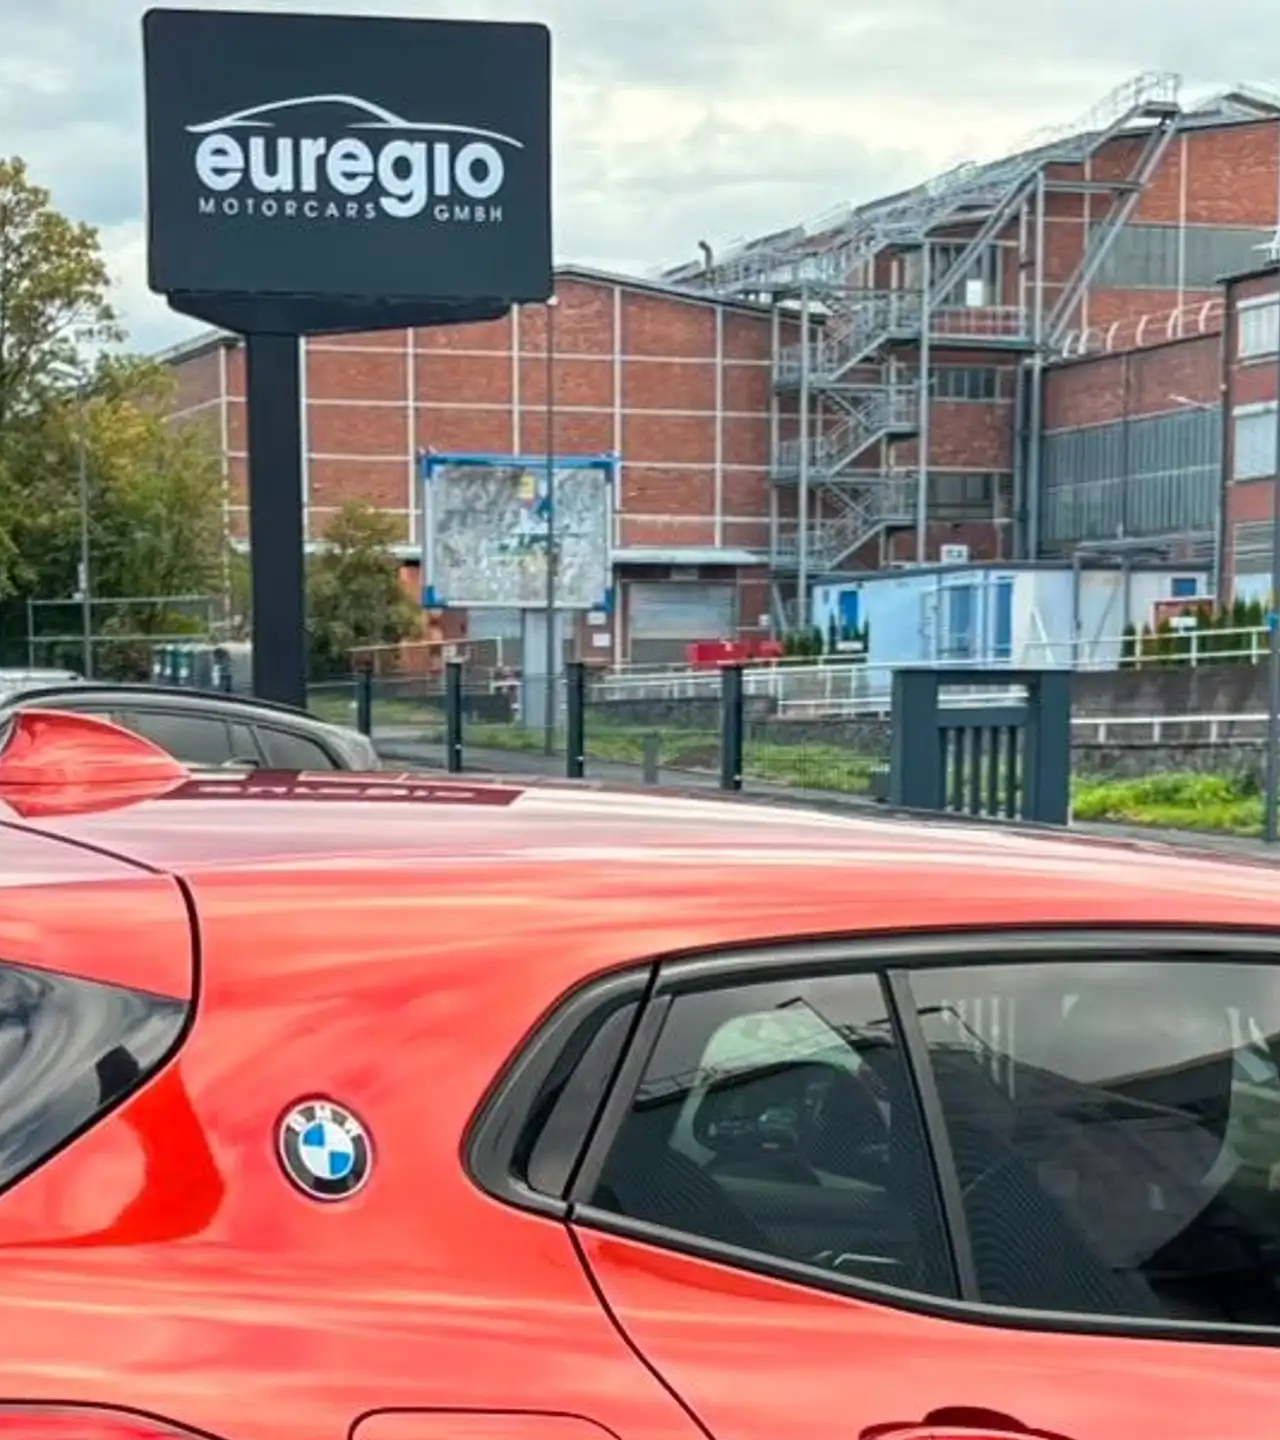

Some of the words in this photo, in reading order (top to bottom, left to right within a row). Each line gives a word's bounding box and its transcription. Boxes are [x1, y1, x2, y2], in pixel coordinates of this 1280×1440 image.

[195, 134, 505, 218] euregio
[198, 198, 377, 219] MOTORCARS
[434, 204, 503, 222] GMBH
